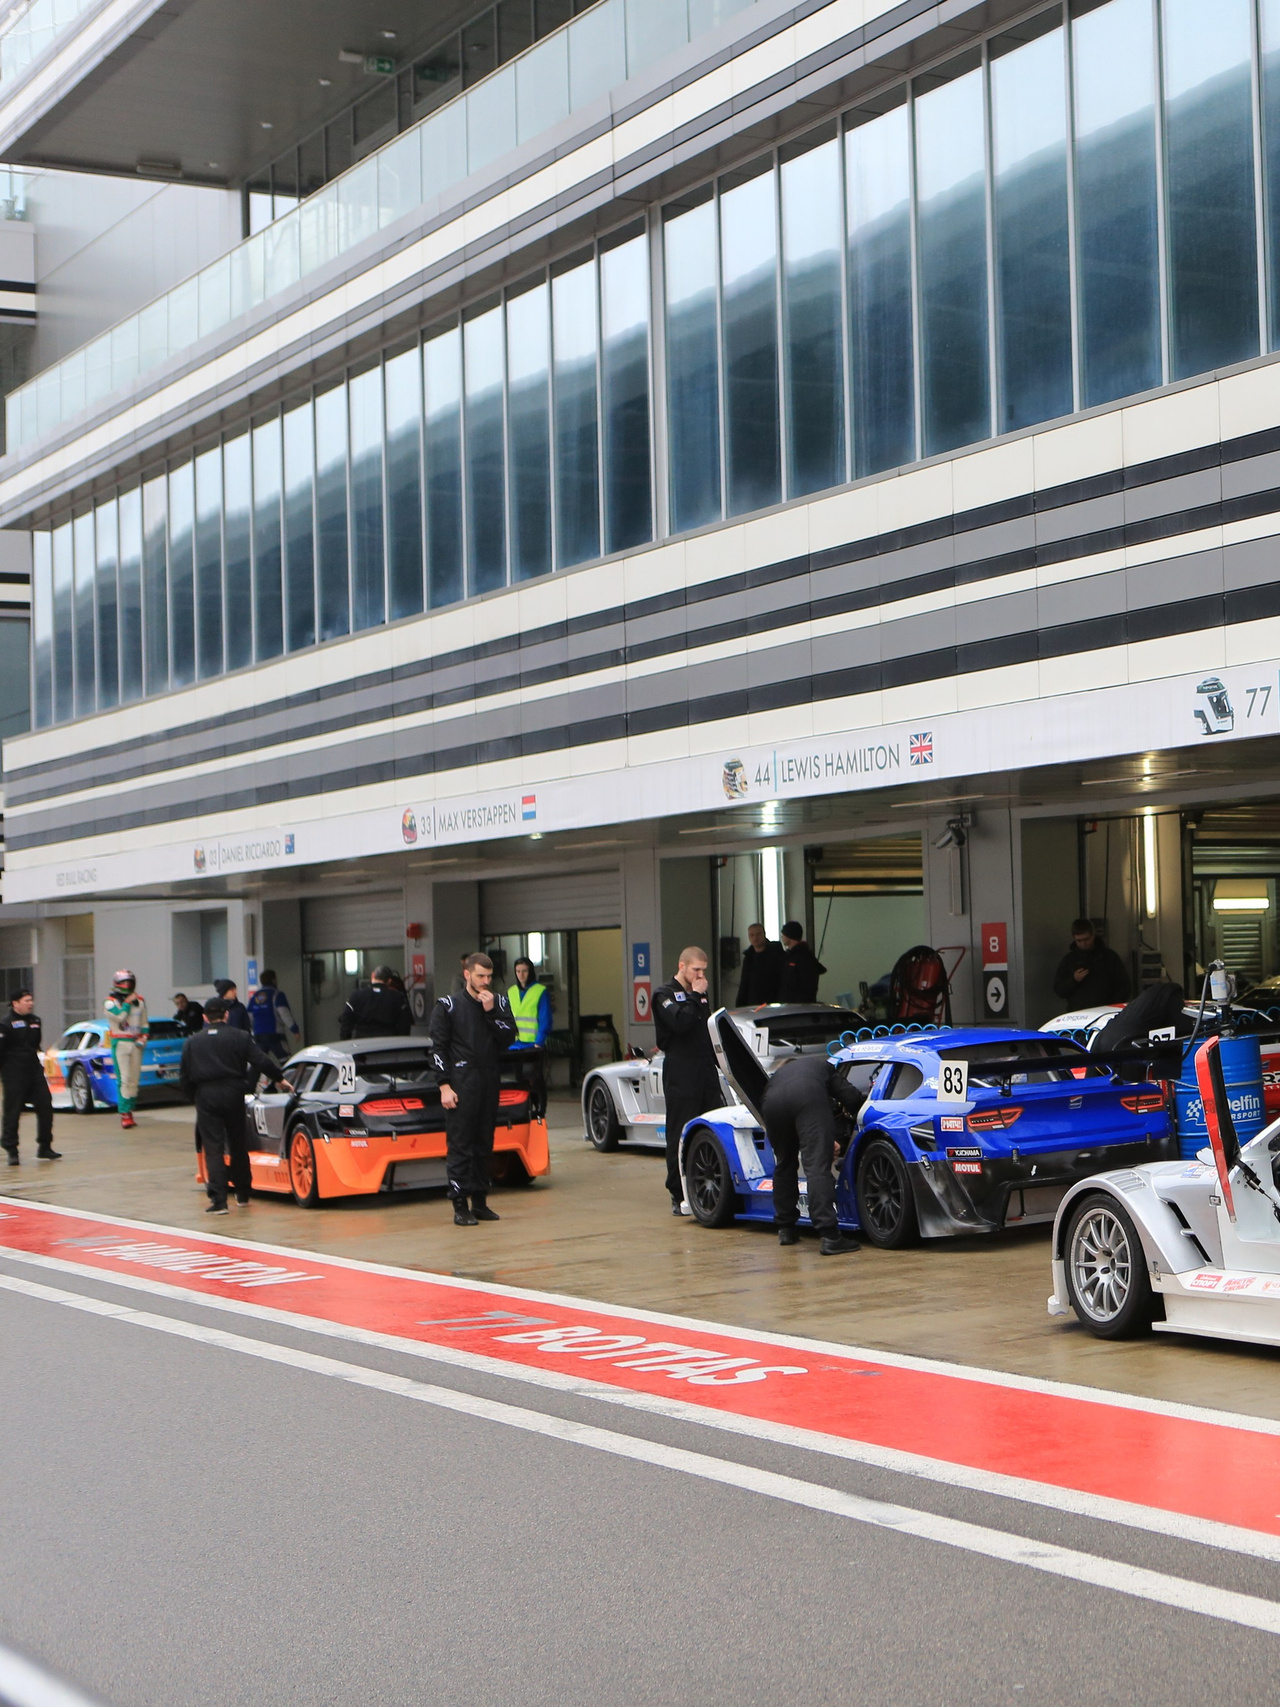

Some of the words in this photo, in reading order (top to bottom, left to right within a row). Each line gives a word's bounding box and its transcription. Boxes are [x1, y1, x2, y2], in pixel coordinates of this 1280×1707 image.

[1246, 686, 1272, 718] 77
[755, 763, 771, 786] 44
[781, 756, 821, 784] LEWIS
[825, 743, 901, 778] HAMILTON
[421, 816, 432, 835] 33
[439, 811, 460, 833] MAX
[460, 803, 516, 828] VERSTAPPEN
[222, 846, 244, 863] DANIEL
[245, 840, 281, 860] RICCIARDO
[989, 936, 999, 952] 8
[415, 964, 423, 975] 10
[637, 953, 645, 968] 9
[755, 1033, 762, 1052] 7
[341, 1065, 353, 1087] 24
[652, 1072, 659, 1094] 7
[944, 1067, 963, 1095] 83
[955, 1163, 981, 1172] MOTUL
[82, 1242, 325, 1288] HAMILTON
[1192, 1279, 1218, 1288] СПОРТ
[1223, 1283, 1251, 1292] ENERGY
[1226, 1276, 1257, 1287] ARCTIC
[414, 1311, 558, 1331] 77
[491, 1325, 809, 1385] BOTTAS
